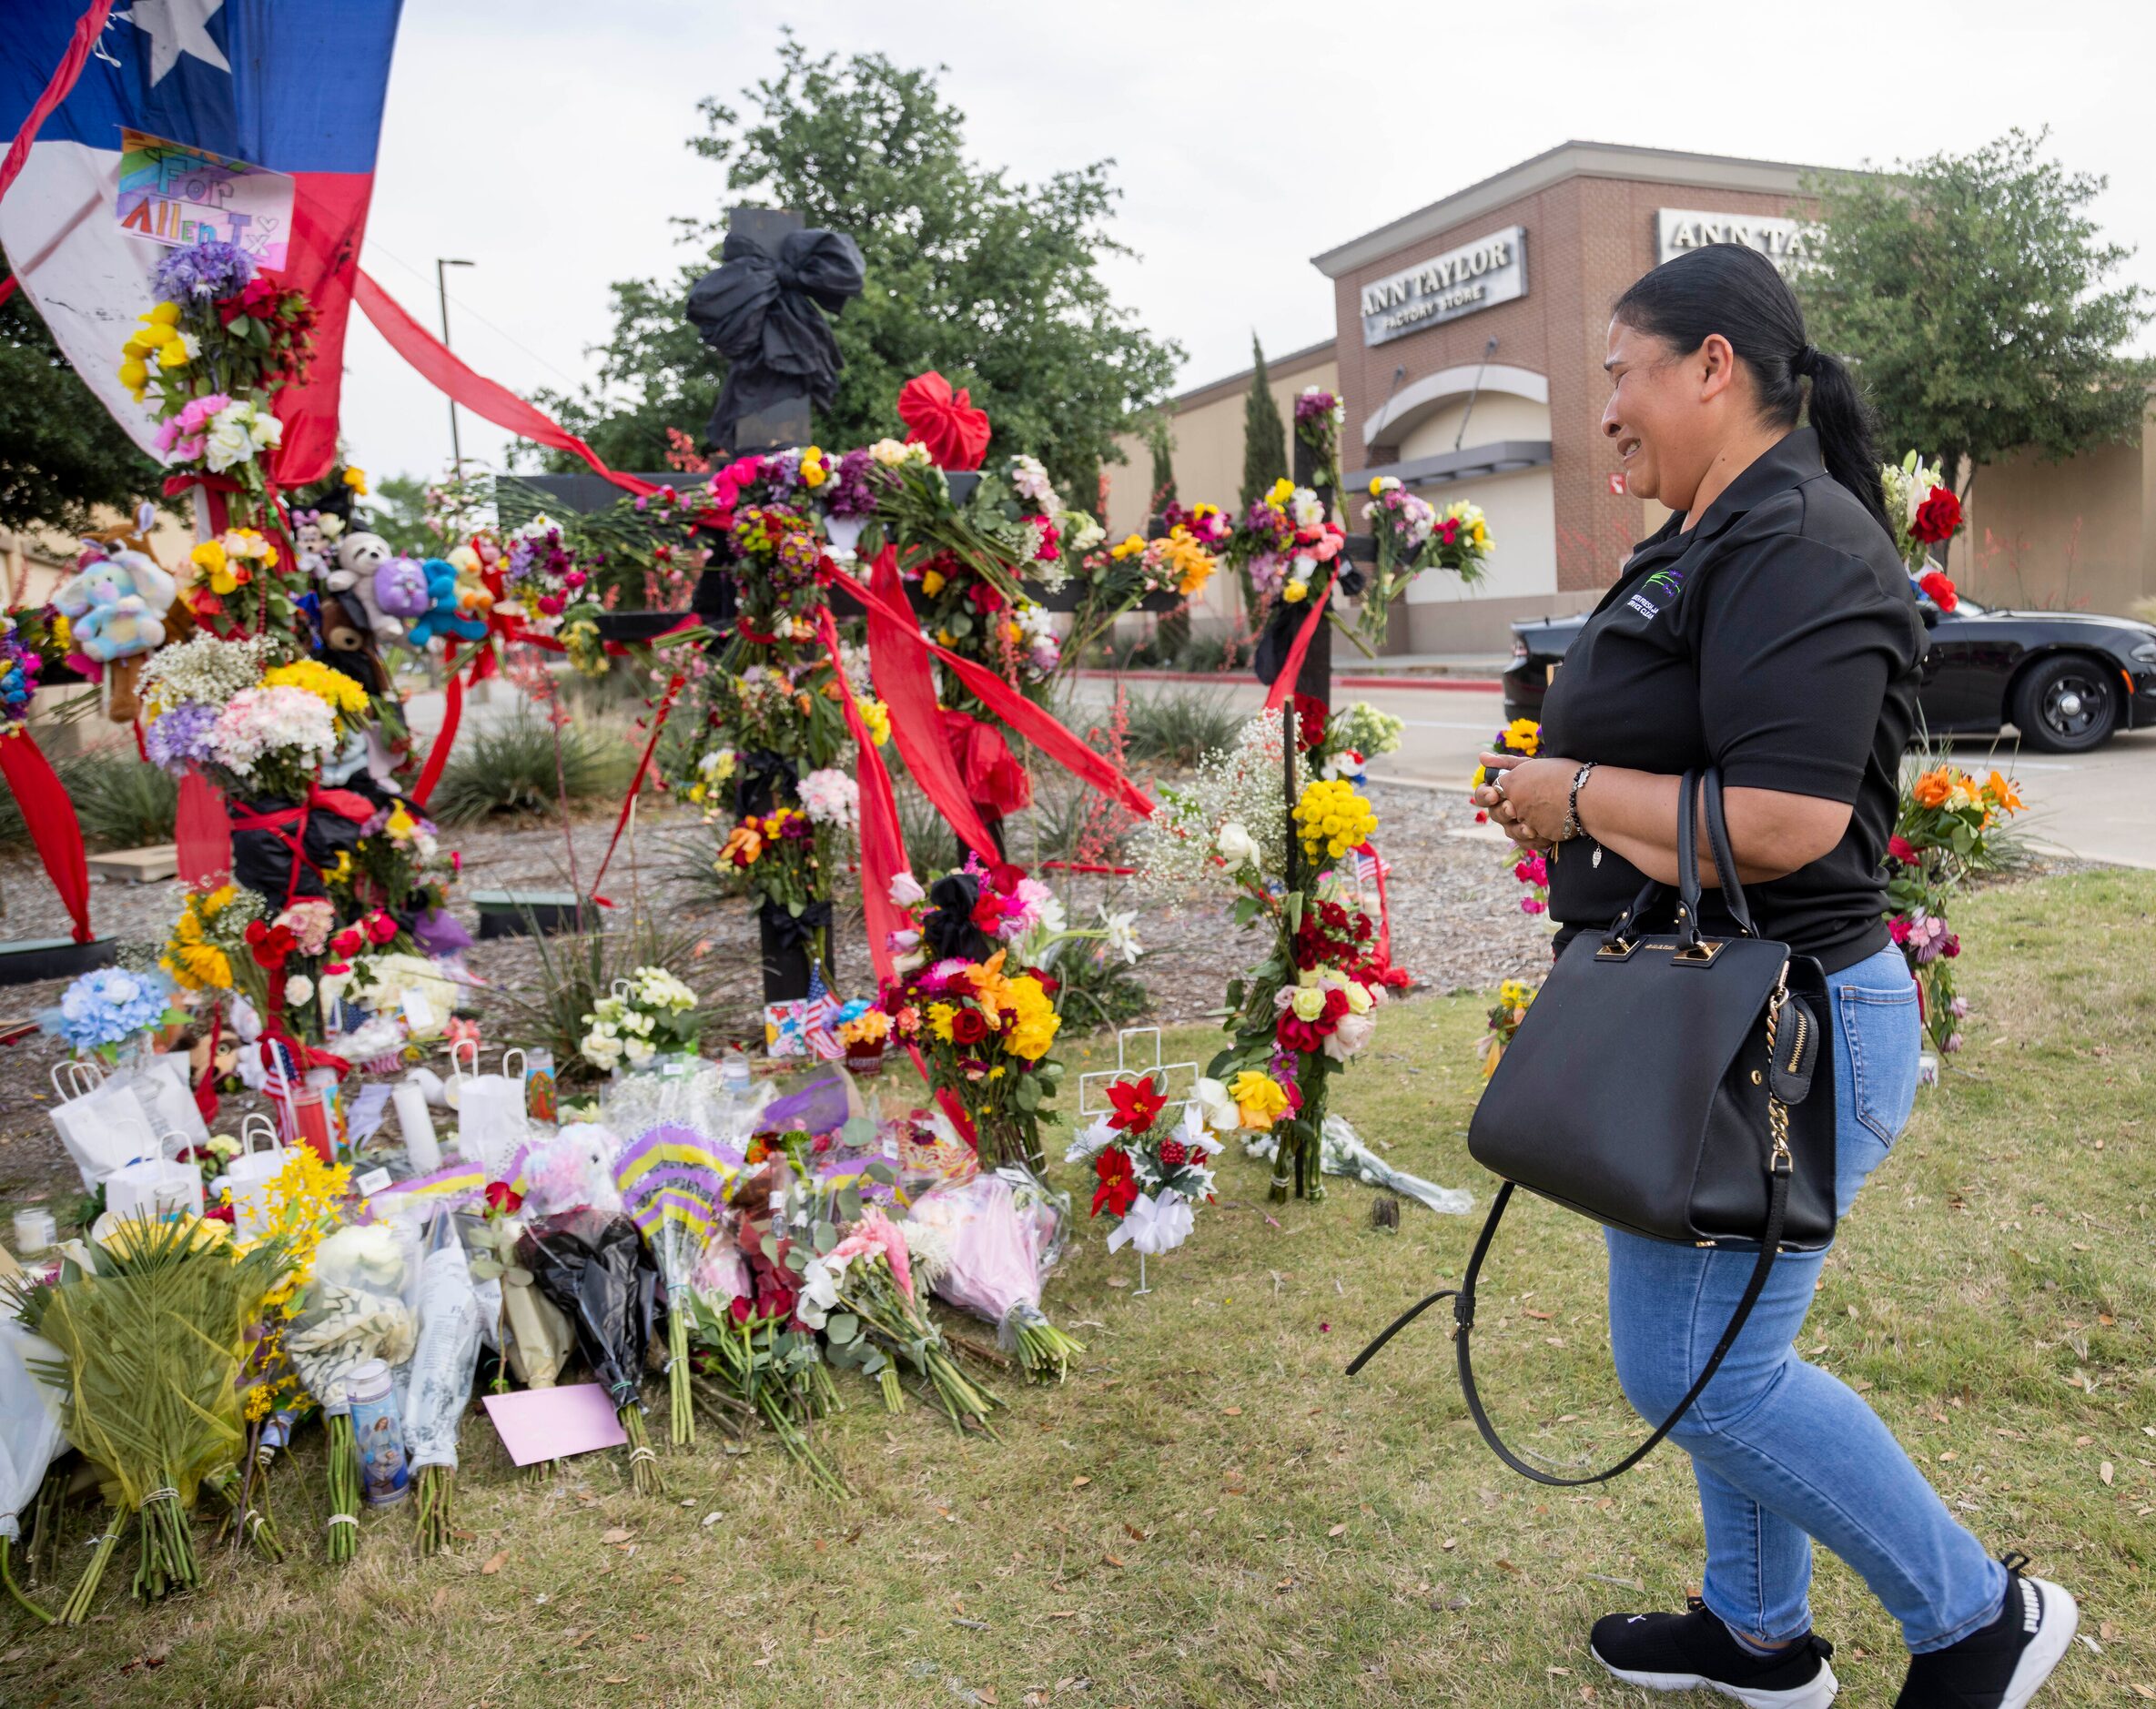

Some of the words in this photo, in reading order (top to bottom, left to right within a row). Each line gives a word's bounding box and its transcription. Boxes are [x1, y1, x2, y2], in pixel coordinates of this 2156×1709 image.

[157, 157, 235, 209] For
[1675, 222, 1750, 248] ANN
[1360, 278, 1407, 317] ANN
[1412, 242, 1509, 297] TAYLOR
[1383, 301, 1435, 329] FACTORY
[1438, 284, 1483, 311] STORE
[1640, 598, 1654, 611] FRESH
[2017, 1577, 2040, 1634] PUMA
